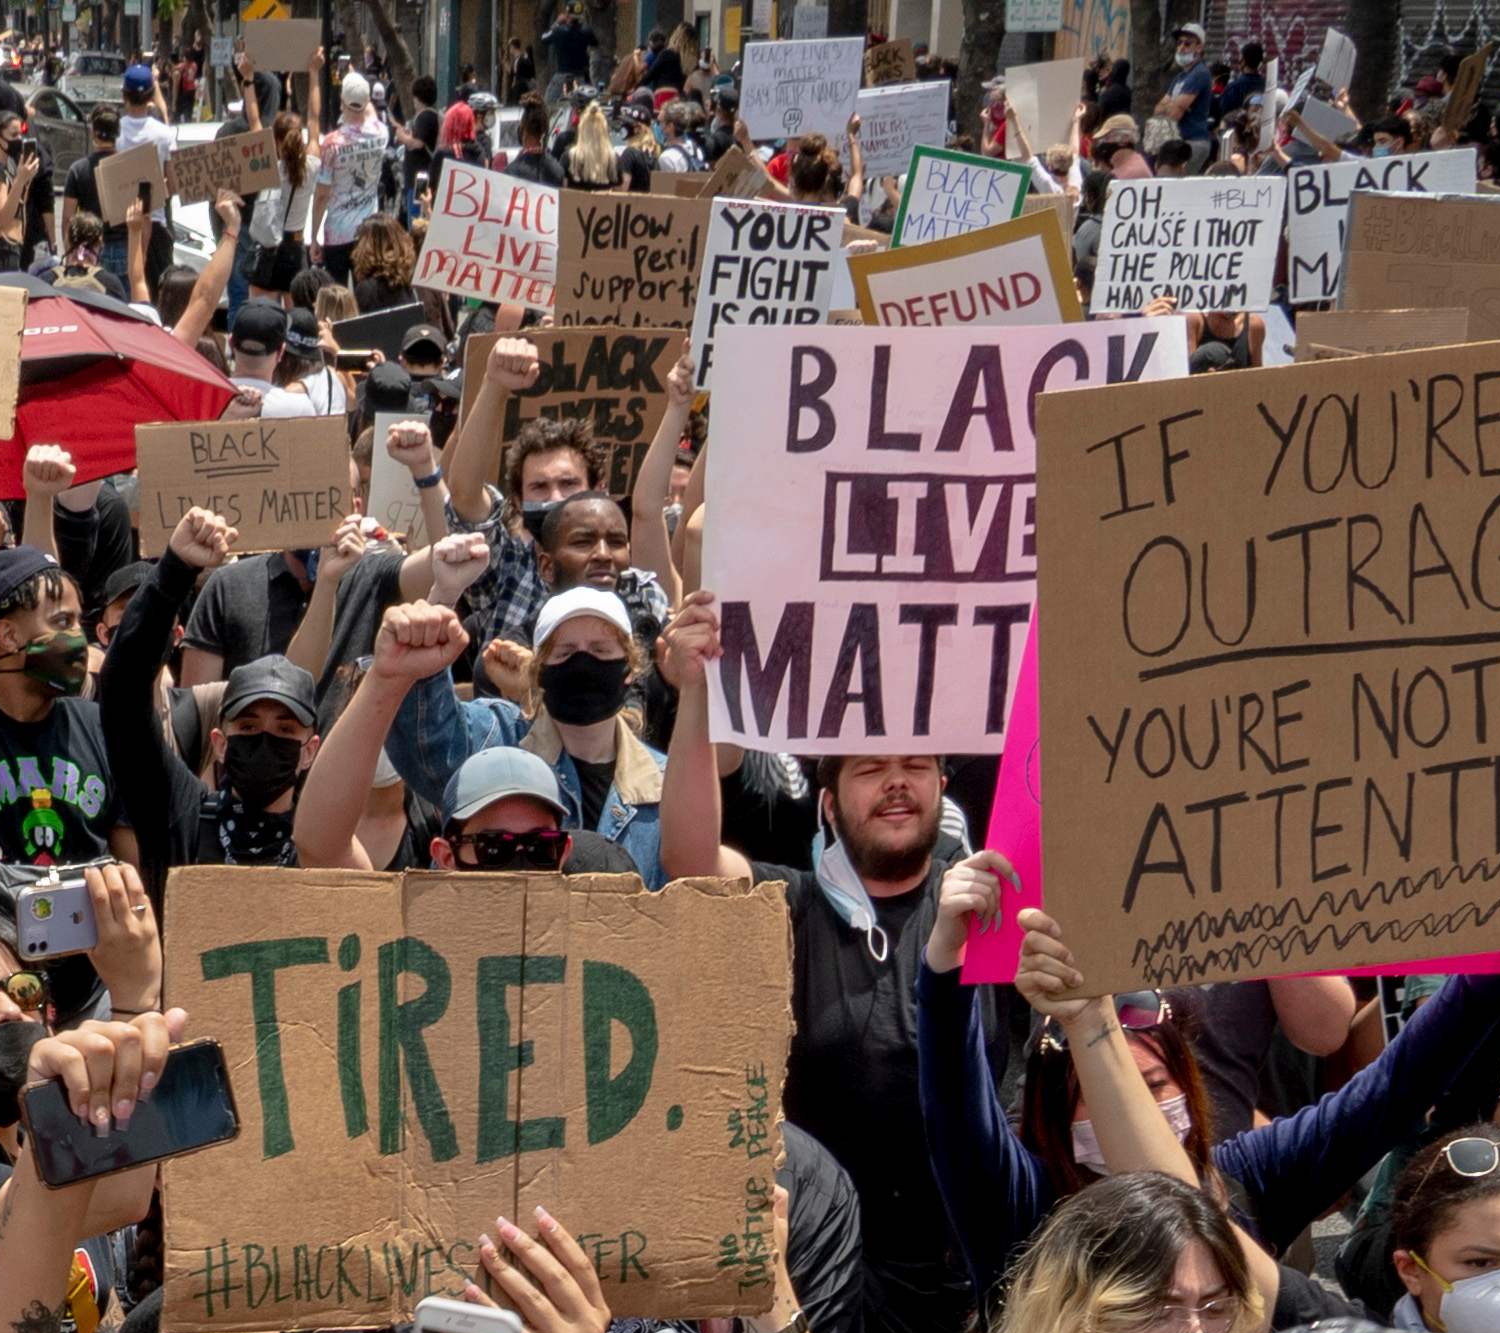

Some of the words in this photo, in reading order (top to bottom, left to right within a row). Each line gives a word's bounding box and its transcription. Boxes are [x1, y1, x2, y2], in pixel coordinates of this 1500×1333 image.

[441, 167, 557, 237] BLAC
[926, 158, 1008, 203] BLACK
[1209, 184, 1274, 210] #BLM
[1294, 159, 1431, 215] BLACK
[576, 202, 674, 259] Yellow
[720, 207, 834, 252] YOUR
[930, 193, 995, 228] LIVES
[1110, 217, 1188, 249] CAUSE
[1193, 218, 1201, 247] I
[1204, 217, 1264, 248] THOT
[462, 224, 557, 274] LIVE
[1108, 251, 1158, 284] THE
[1168, 250, 1244, 281] POLICE
[709, 254, 830, 304] FIGHT
[880, 270, 1043, 327] DEFUND
[1104, 284, 1144, 310] HAD
[1195, 282, 1248, 310] SUM
[190, 427, 281, 467] BLACK
[1085, 408, 1204, 522] IF
[257, 482, 345, 527] MATTER
[719, 599, 1031, 739] MATT
[1086, 679, 1312, 784] YOU'RE
